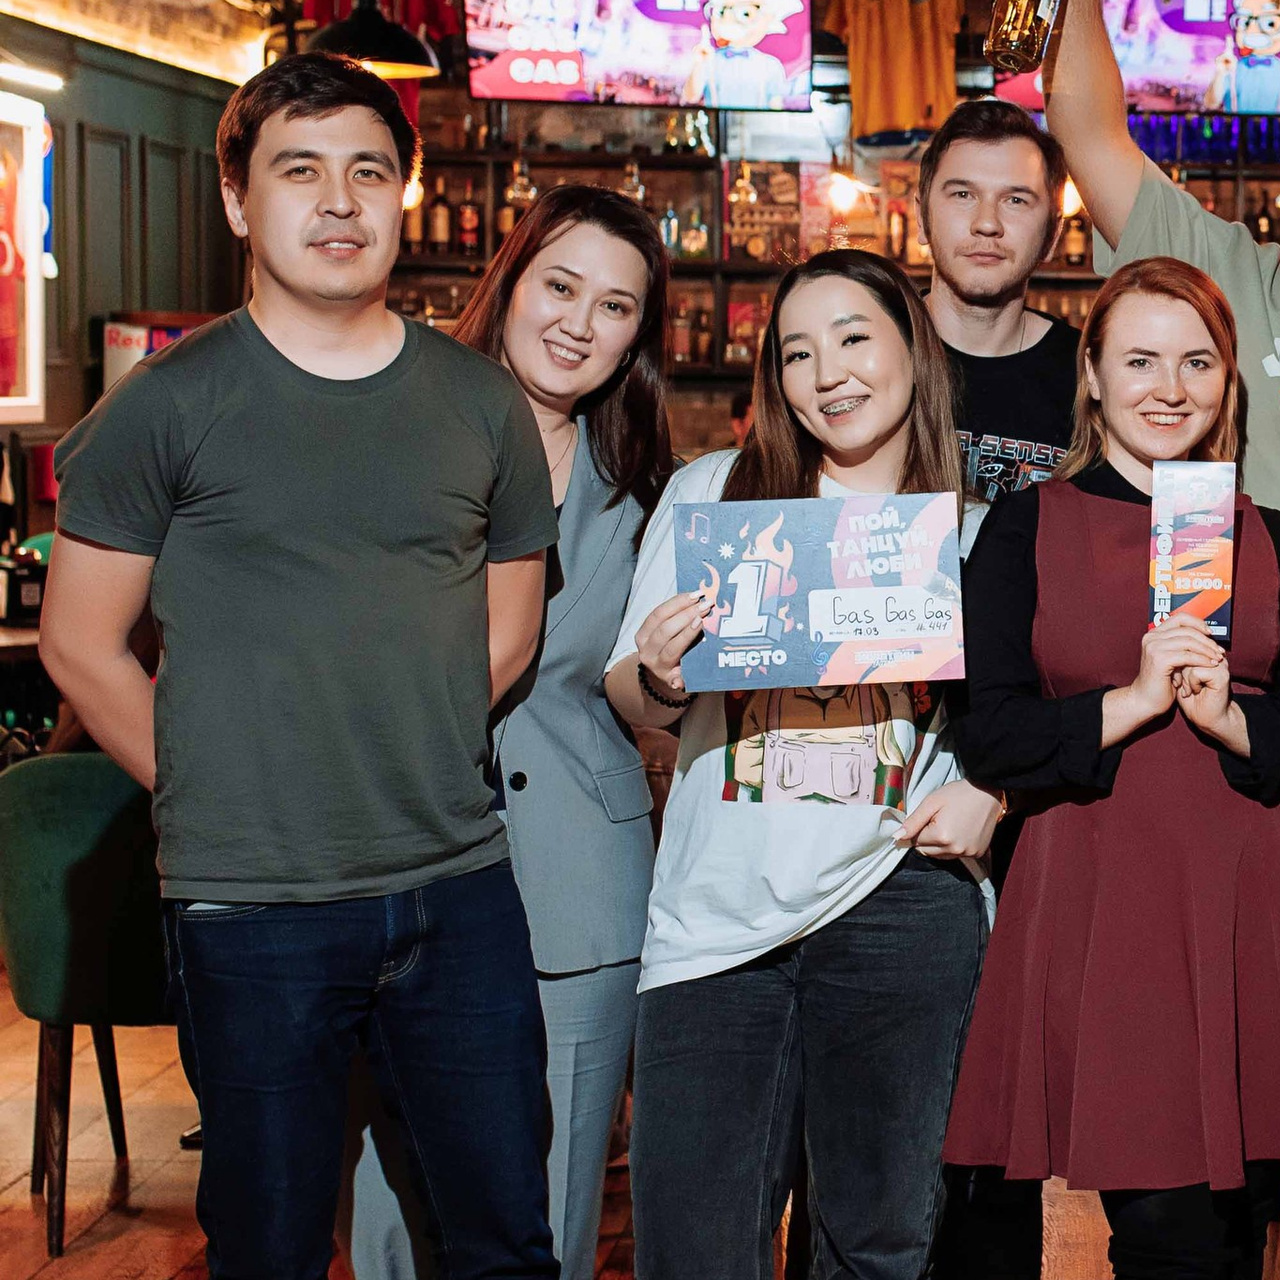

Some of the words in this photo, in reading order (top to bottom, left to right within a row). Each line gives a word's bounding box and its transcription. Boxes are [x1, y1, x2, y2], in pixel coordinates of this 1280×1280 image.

[509, 57, 580, 86] GAS
[846, 552, 923, 580] ЛЮБИ
[719, 561, 768, 640] 1
[832, 596, 875, 625] Gas
[885, 596, 917, 623] Gas
[924, 598, 952, 620] Gas
[717, 648, 788, 669] МЕСТО
